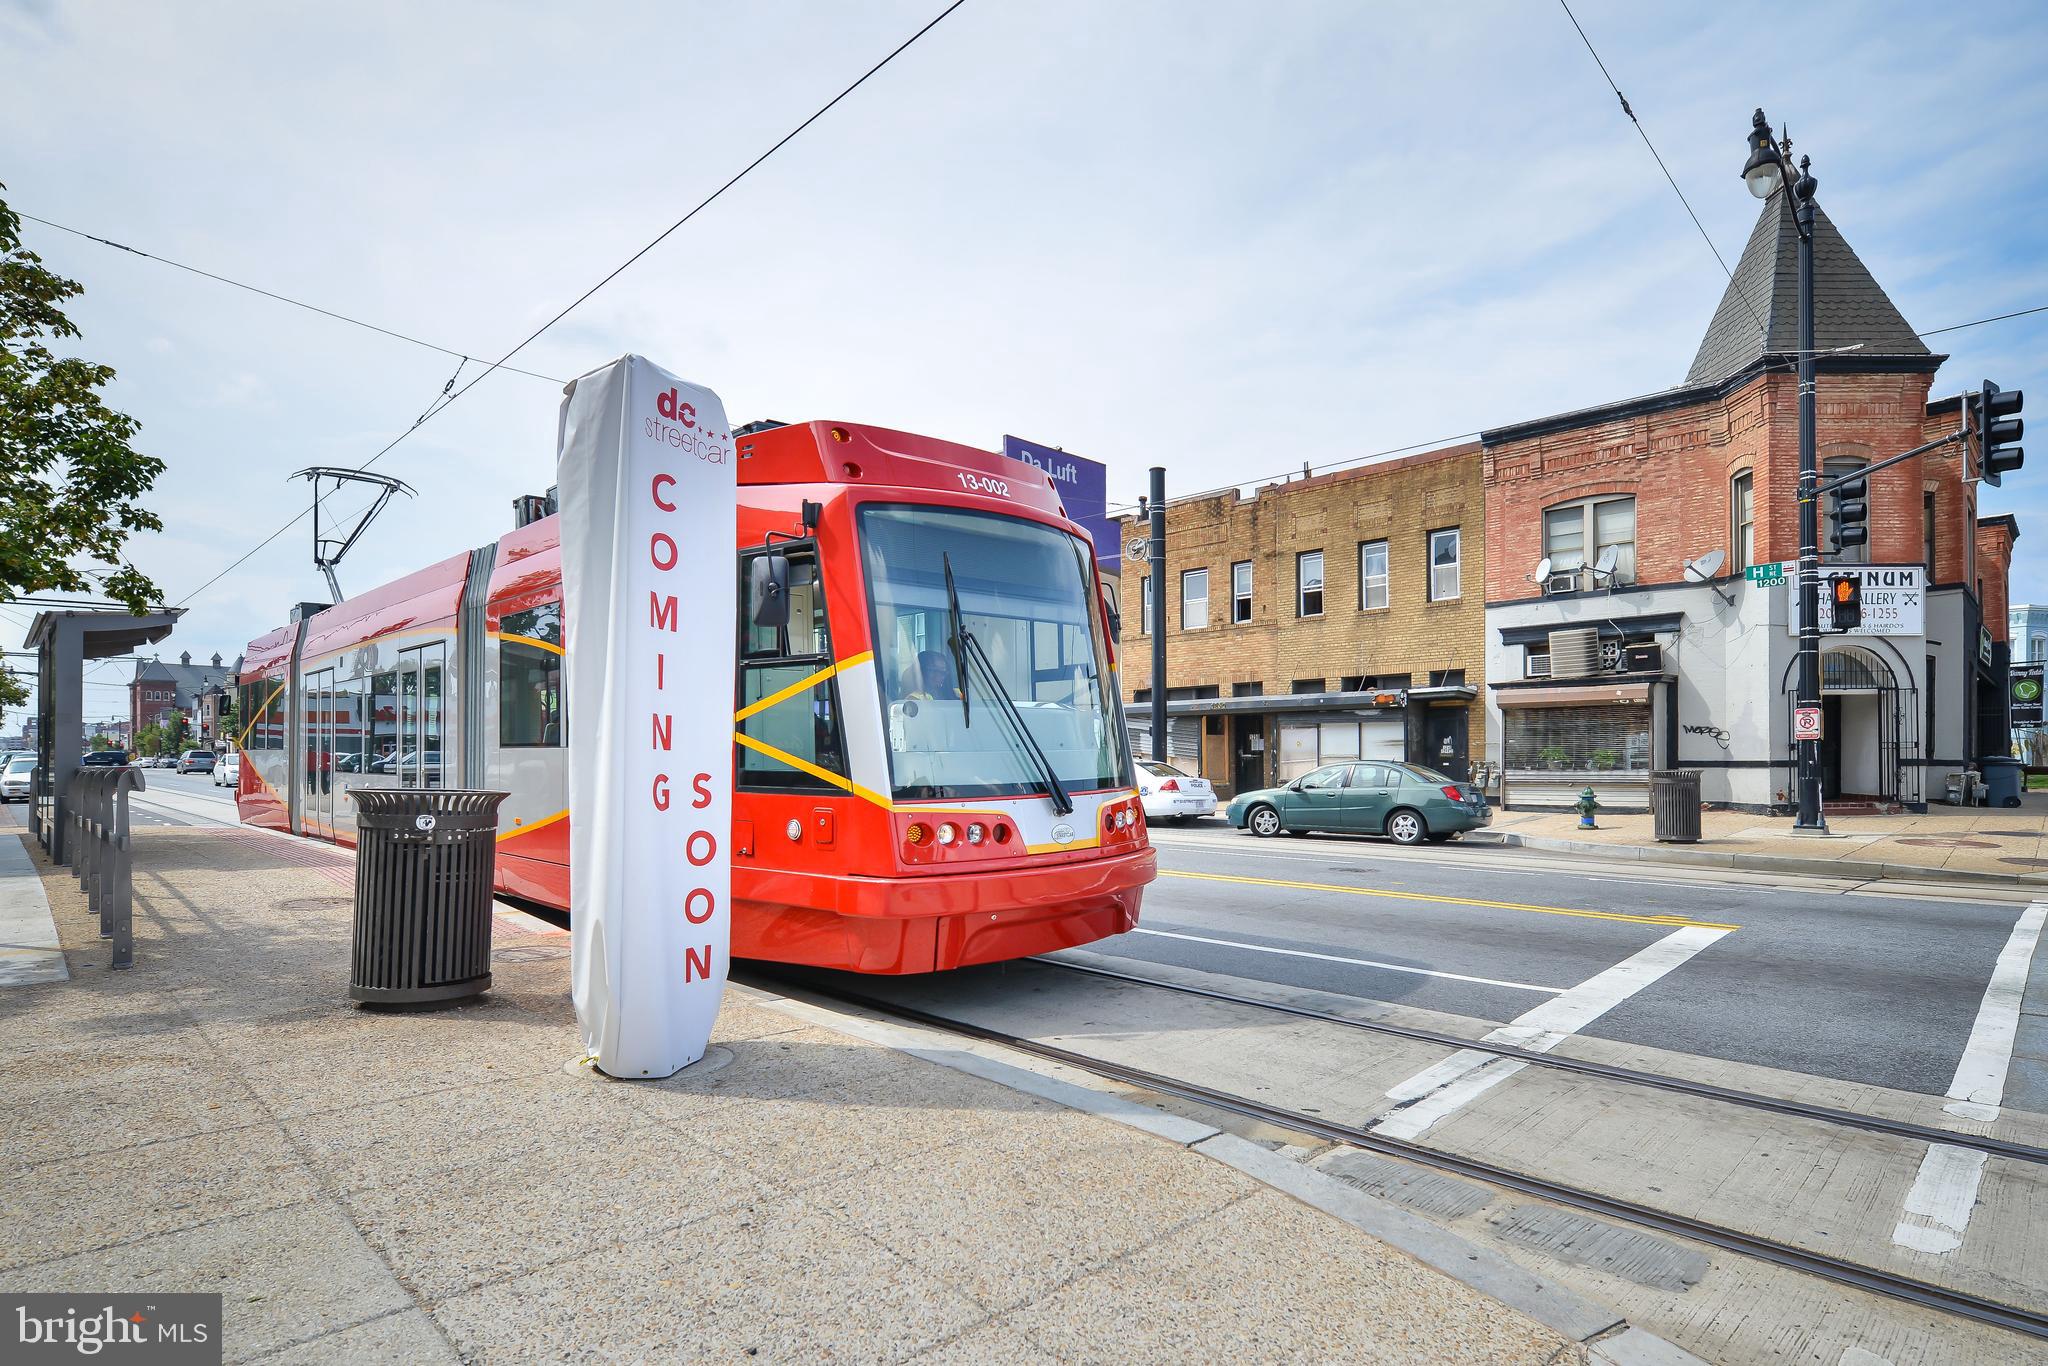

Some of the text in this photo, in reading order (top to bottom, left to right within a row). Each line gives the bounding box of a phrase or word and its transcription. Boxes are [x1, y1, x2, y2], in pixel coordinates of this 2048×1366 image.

[657, 387, 696, 429] dc
[644, 416, 731, 465] streetcar
[1048, 458, 1078, 484] Luft
[957, 472, 1011, 498] 13-002
[1752, 566, 1764, 578] H
[1758, 577, 1786, 587] 1200
[1860, 592, 1897, 605] ALLERY
[650, 473, 679, 812] COMING
[684, 772, 717, 984] SOON
